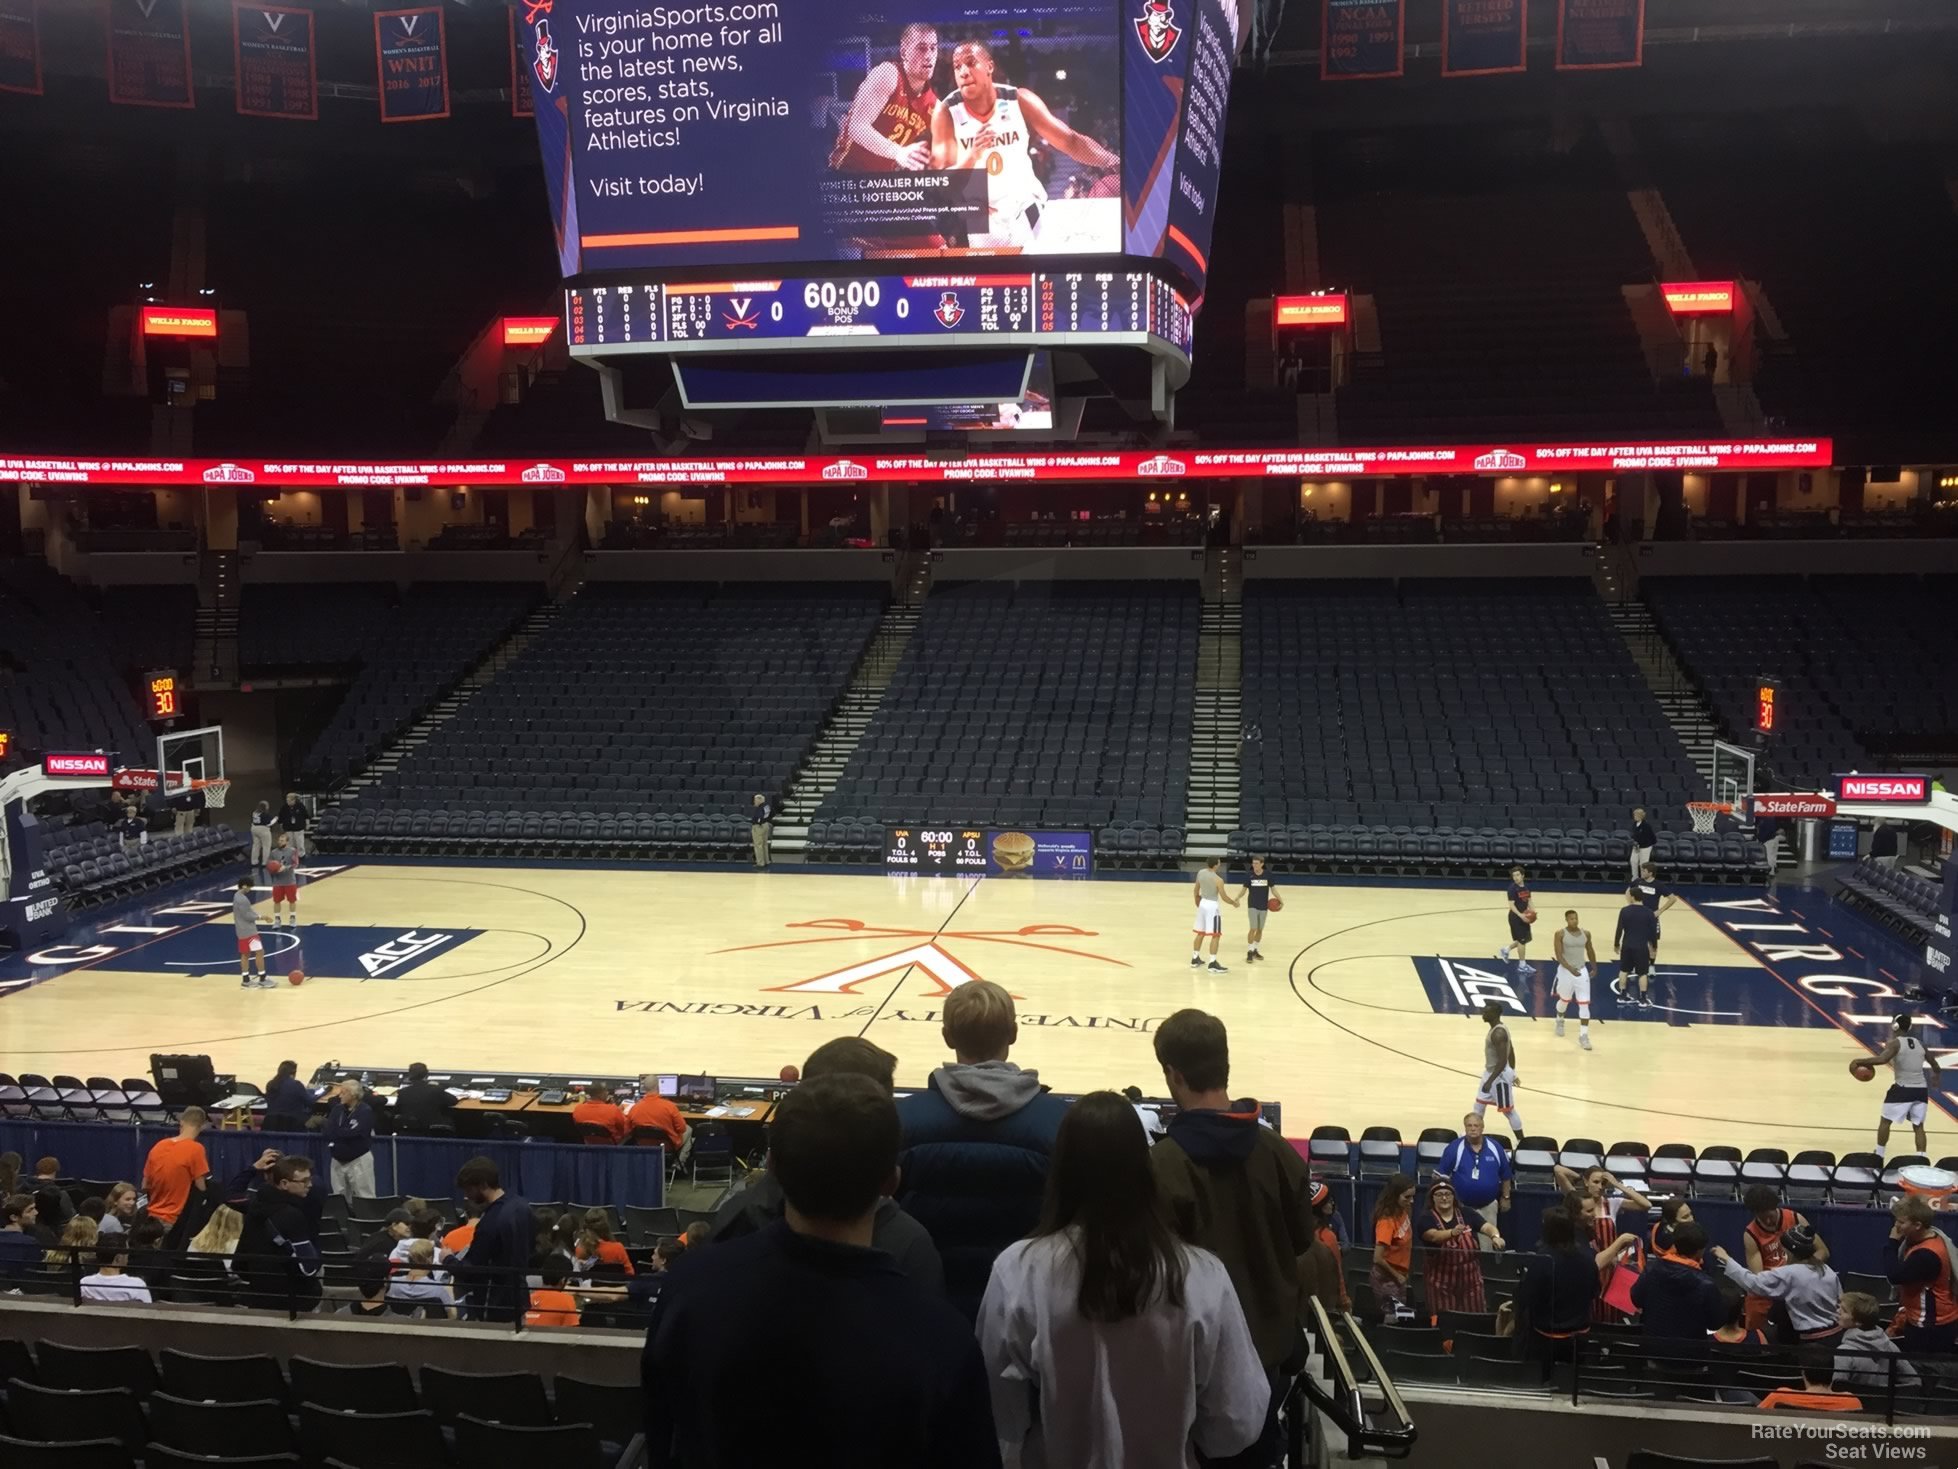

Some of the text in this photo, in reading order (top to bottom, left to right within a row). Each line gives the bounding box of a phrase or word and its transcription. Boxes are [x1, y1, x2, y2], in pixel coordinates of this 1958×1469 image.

[576, 2, 779, 36] VirginiaSports.com
[578, 23, 782, 61] is your home for all
[388, 56, 435, 75] WNIT
[580, 53, 744, 81] the latest news,
[386, 76, 441, 91] 2016 2017
[583, 78, 715, 106] scores, stats,
[584, 97, 789, 128] features on Virginia
[587, 128, 681, 151] Athletics!
[590, 173, 705, 198] Visit today!
[859, 178, 912, 190] CAVALIER
[914, 176, 949, 188] MEN'S
[862, 191, 924, 203] NOTEBOOK
[912, 277, 949, 288] AUSTIN
[1066, 273, 1082, 282] PTS
[1095, 273, 1113, 282] REB
[592, 287, 607, 296] PTS
[804, 280, 880, 309] 60:00
[771, 299, 783, 321] 0
[827, 306, 859, 316] BONUS
[897, 298, 909, 318] 0
[834, 315, 852, 324] POS
[981, 322, 999, 331] TOL
[672, 330, 688, 338] TOL
[1212, 455, 1227, 464] OFF
[1229, 454, 1244, 464] THE
[1245, 454, 1260, 463] DAY
[1261, 453, 1286, 463] AFTER
[1287, 453, 1303, 463] UVA
[1304, 452, 1353, 462] BASKETBALL
[1355, 451, 1376, 461] WINS
[1556, 448, 1571, 457] OFF
[1573, 448, 1589, 457] THE
[1591, 448, 1606, 456] DAY
[1608, 447, 1634, 456] AFTER
[1636, 447, 1653, 456] UVA
[1654, 446, 1707, 455] BASKETBALL
[1709, 446, 1731, 455] WINS
[590, 463, 603, 471] OFF
[604, 463, 618, 471] THE
[619, 463, 633, 471] DAY
[633, 463, 655, 471] AFTER
[656, 463, 670, 471] UVA
[671, 462, 715, 470] BASKETBALL
[717, 462, 735, 470] WINS
[1476, 456, 1496, 468] PAPA
[1613, 456, 1718, 467] PROMO CODE: UVAWINS
[824, 468, 842, 478] PAPA
[944, 469, 1035, 478] PROMO CODE: UVAWINS
[1140, 462, 1158, 474] PAPA
[1266, 463, 1363, 474] PROMO CODE: UVAWINS
[205, 470, 226, 480] PAPA
[523, 472, 540, 480] PAPA
[638, 472, 725, 481] PROMO CODE: UVAWINS
[156, 691, 174, 714] 30
[1760, 703, 1773, 729] 30
[50, 759, 105, 771] NISSAN
[133, 775, 156, 788] State
[1847, 782, 1922, 795] NISSAN
[1768, 801, 1828, 814] State Farm
[895, 830, 909, 838] UVA
[898, 839, 905, 849] 0
[967, 839, 975, 850] 0
[964, 858, 986, 866] FOULS
[31, 869, 45, 880] UVA
[32, 897, 58, 911] UNITED
[34, 907, 53, 920] BANK
[358, 930, 445, 974] ACC
[1453, 962, 1528, 1014] ACC
[613, 999, 827, 1022] VIRGINIA
